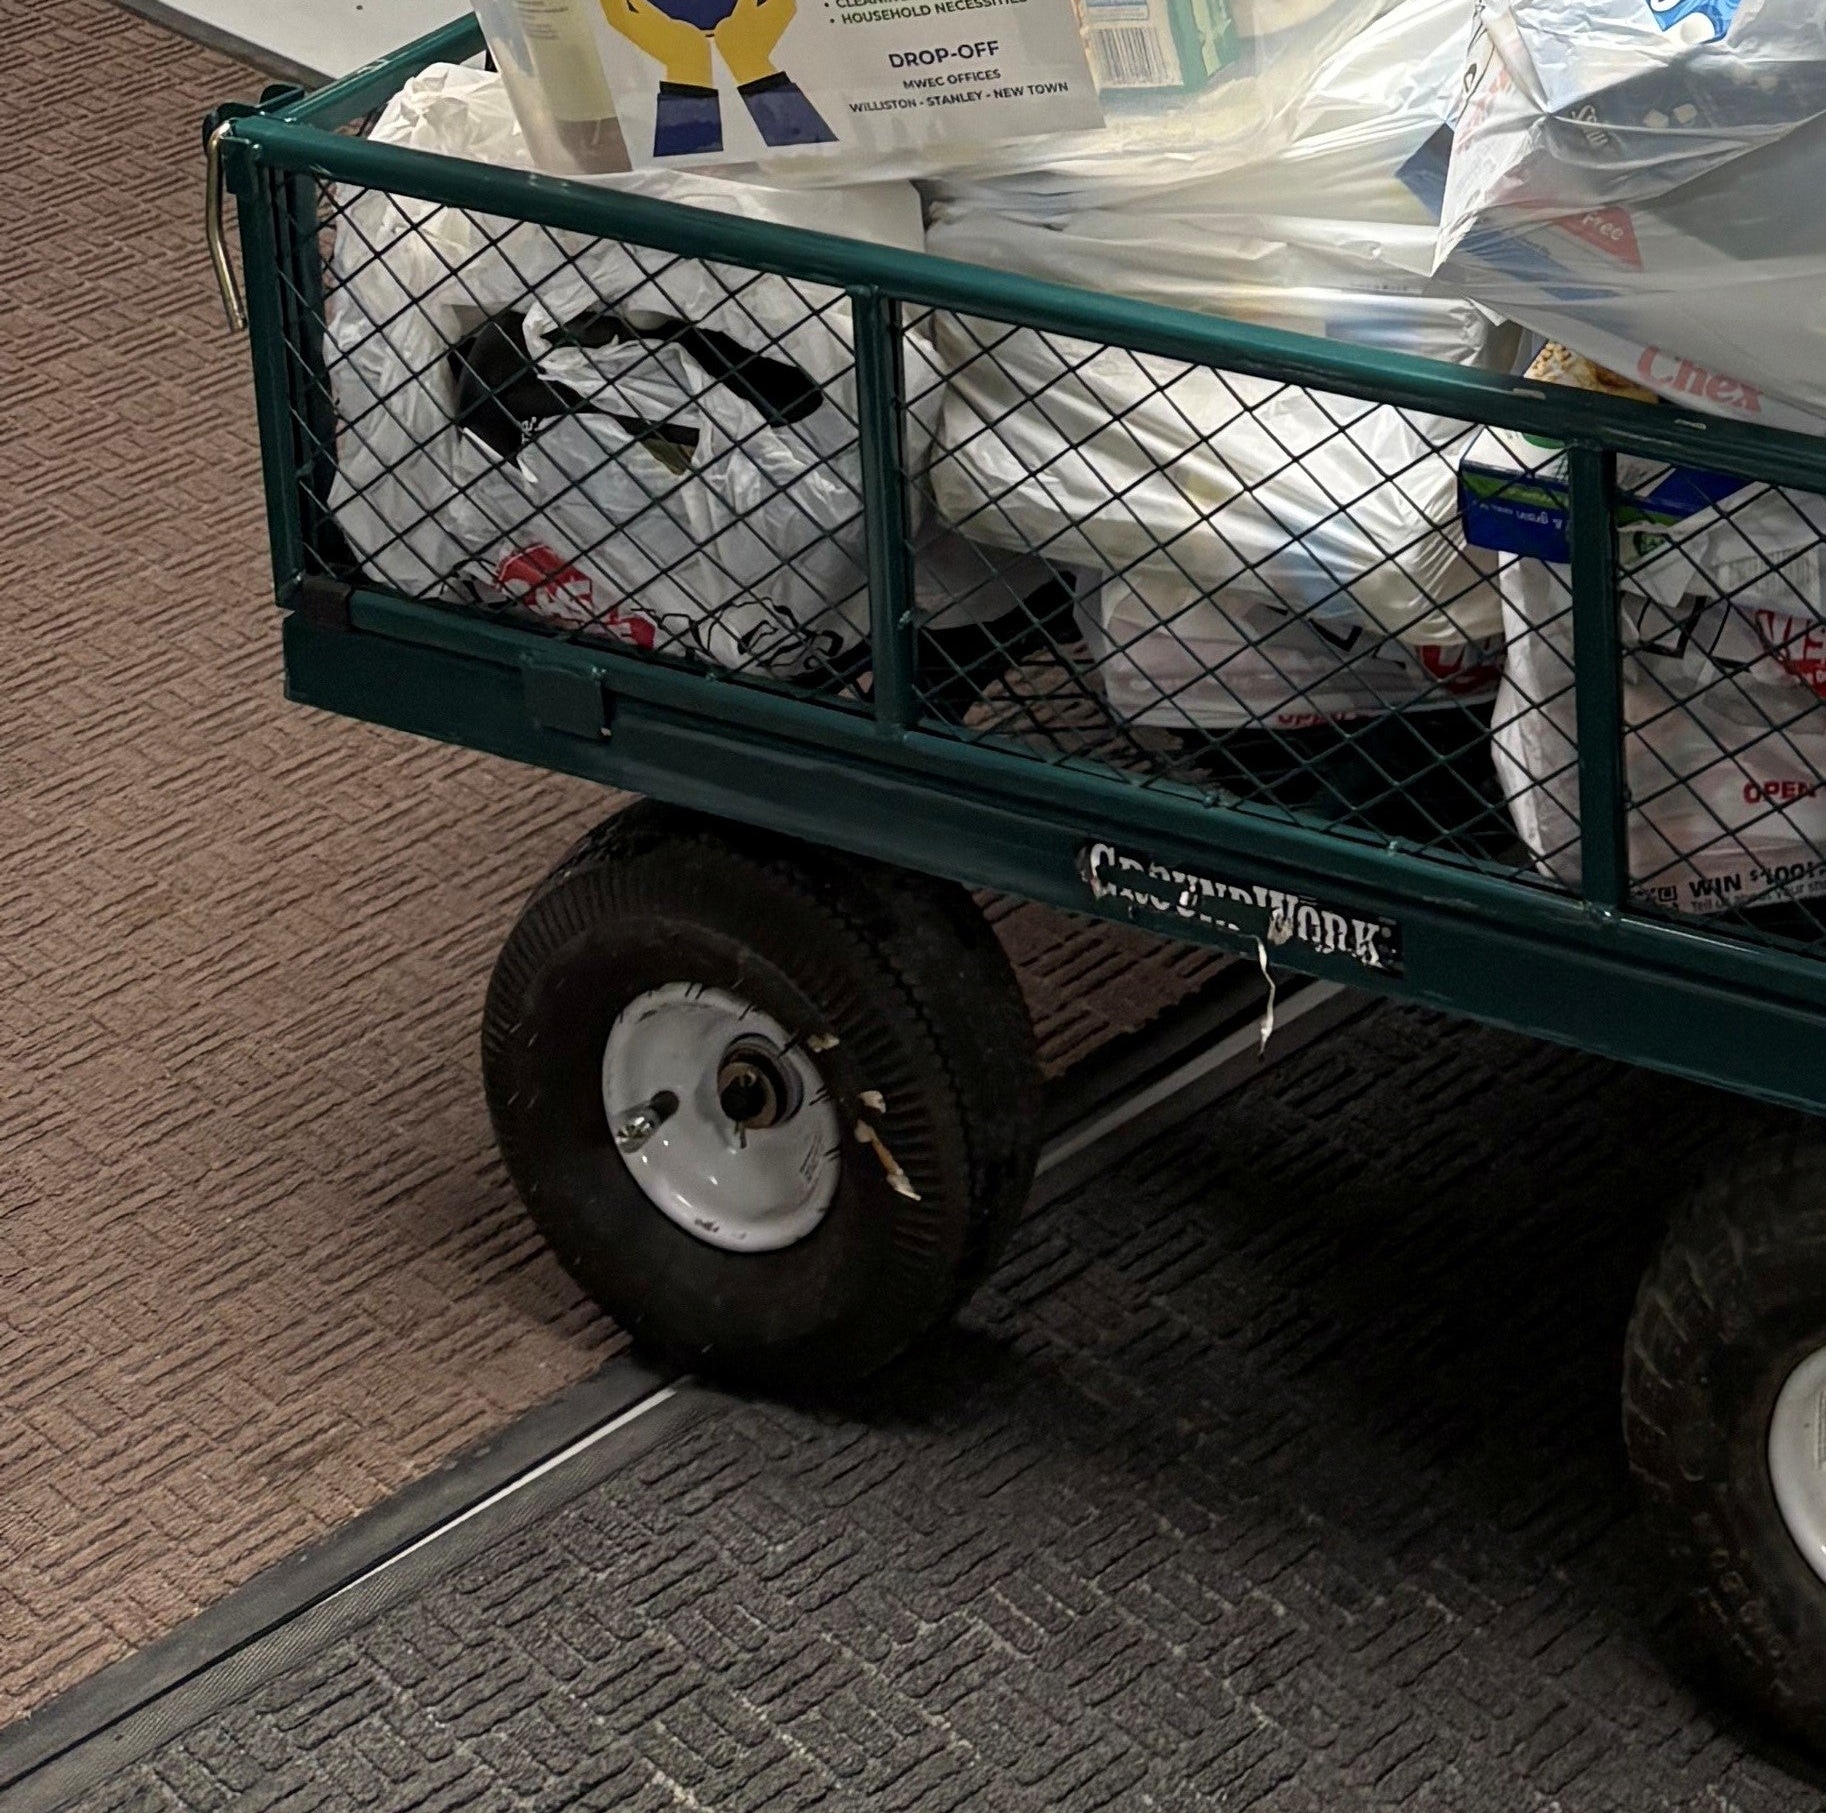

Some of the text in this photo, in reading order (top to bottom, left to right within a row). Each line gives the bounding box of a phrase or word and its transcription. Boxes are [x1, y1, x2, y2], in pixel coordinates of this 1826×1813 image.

[841, 4, 932, 25] HOUSEHOLD
[888, 40, 1000, 69] DROP-OFF
[903, 68, 1001, 90] MWEC OFFICES
[849, 82, 1069, 114] WILLISTON STANLEY NEW TOWN
[1743, 779, 1816, 805] OPEN
[1689, 873, 1742, 898] WIN
